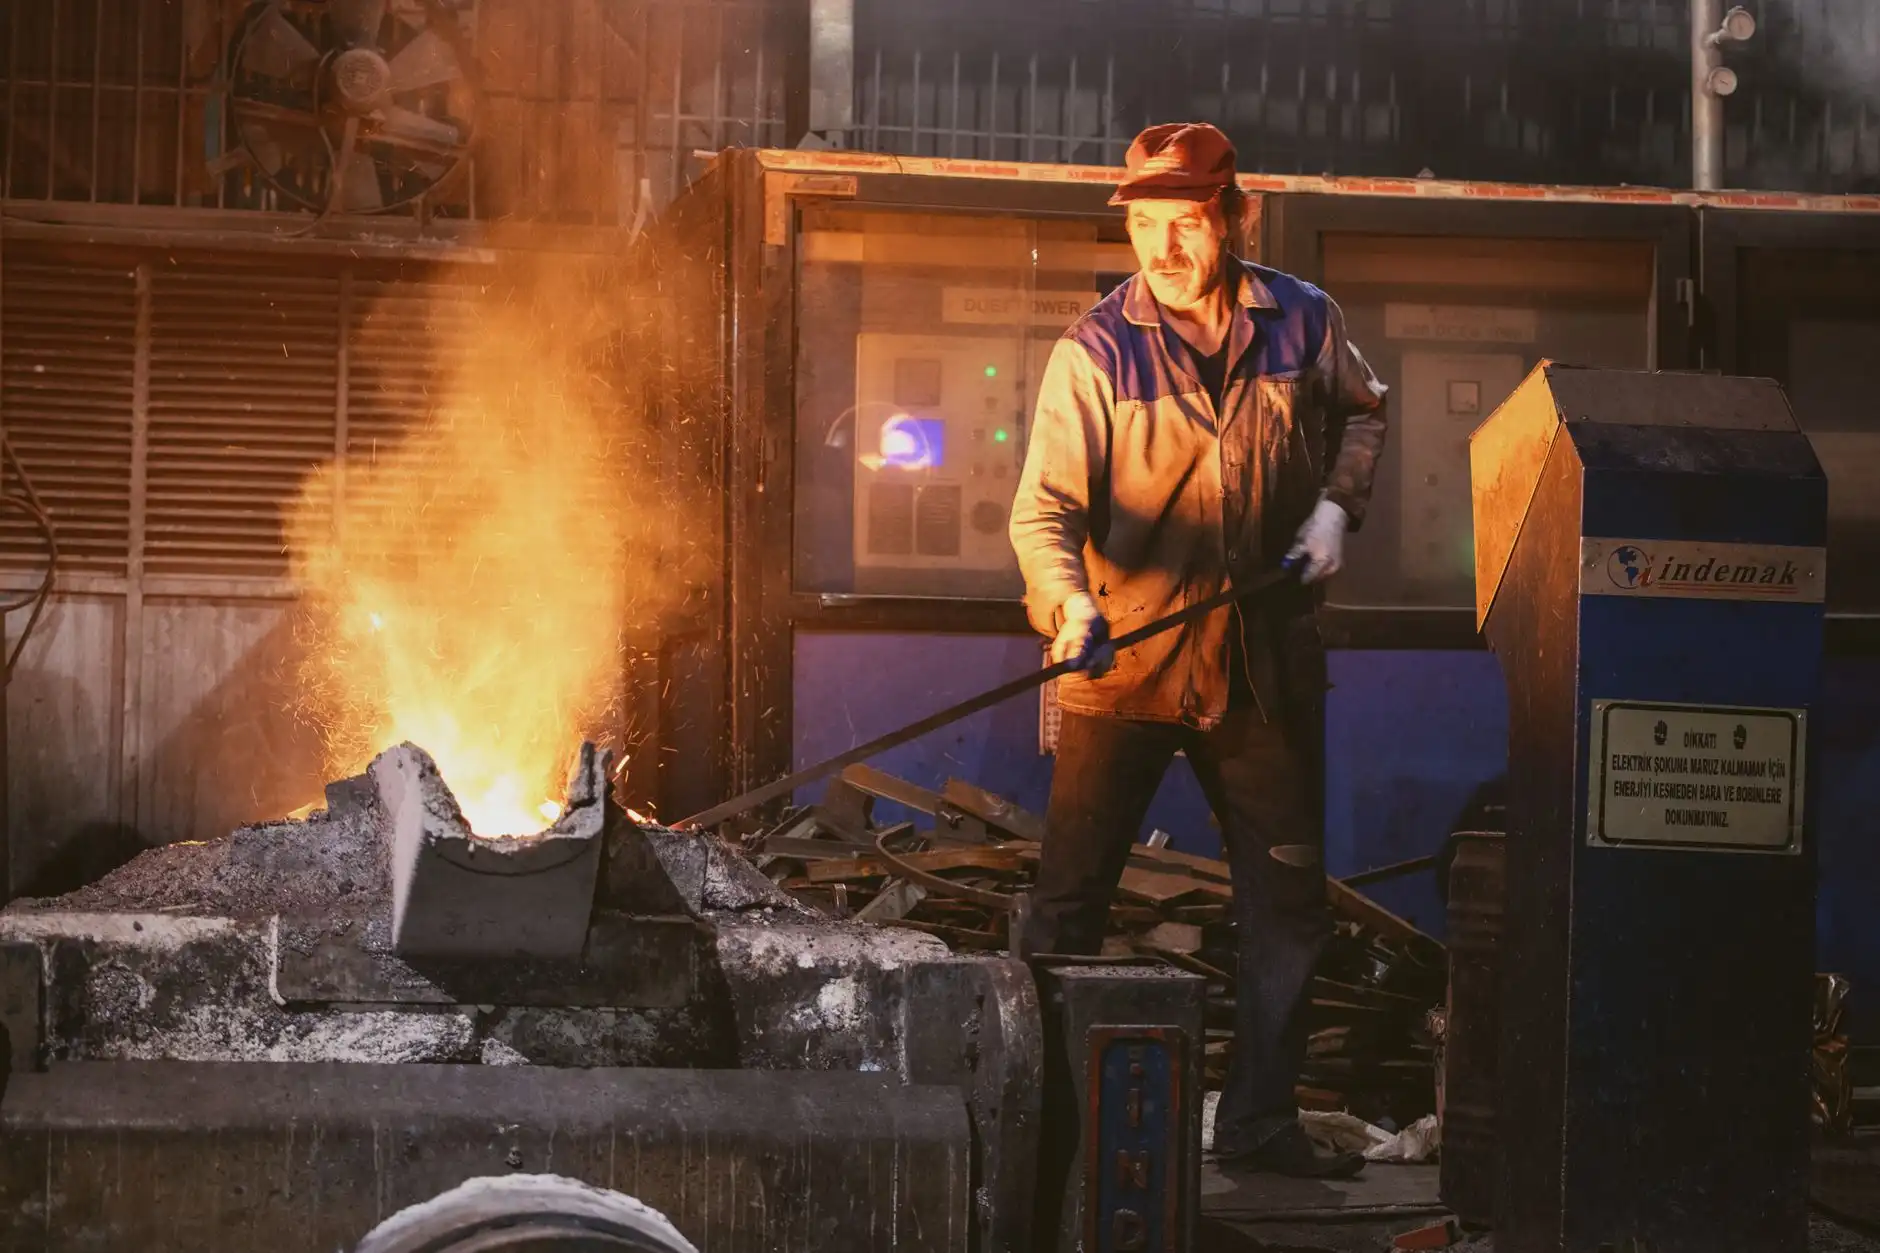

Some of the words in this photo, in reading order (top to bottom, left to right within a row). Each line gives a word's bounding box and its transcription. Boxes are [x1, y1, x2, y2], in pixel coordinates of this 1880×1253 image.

[1018, 298, 1081, 316] OWER
[1657, 556, 1799, 586] indemak
[1612, 752, 1653, 773] ELEKTRİK
[1654, 756, 1689, 777] ŞOKUNA
[1690, 757, 1720, 776] MARUZ
[1721, 758, 1767, 778] KALMAMAK
[1768, 757, 1786, 782] İÇİN
[1614, 777, 1652, 799] ENERJİYİ
[1653, 782, 1698, 801] KESMEDEN
[1699, 783, 1722, 802] BARA
[1723, 784, 1736, 803] VE
[1736, 784, 1783, 804] BOBİNLERE
[1665, 807, 1730, 829] DOKUNMAYINIZ.
